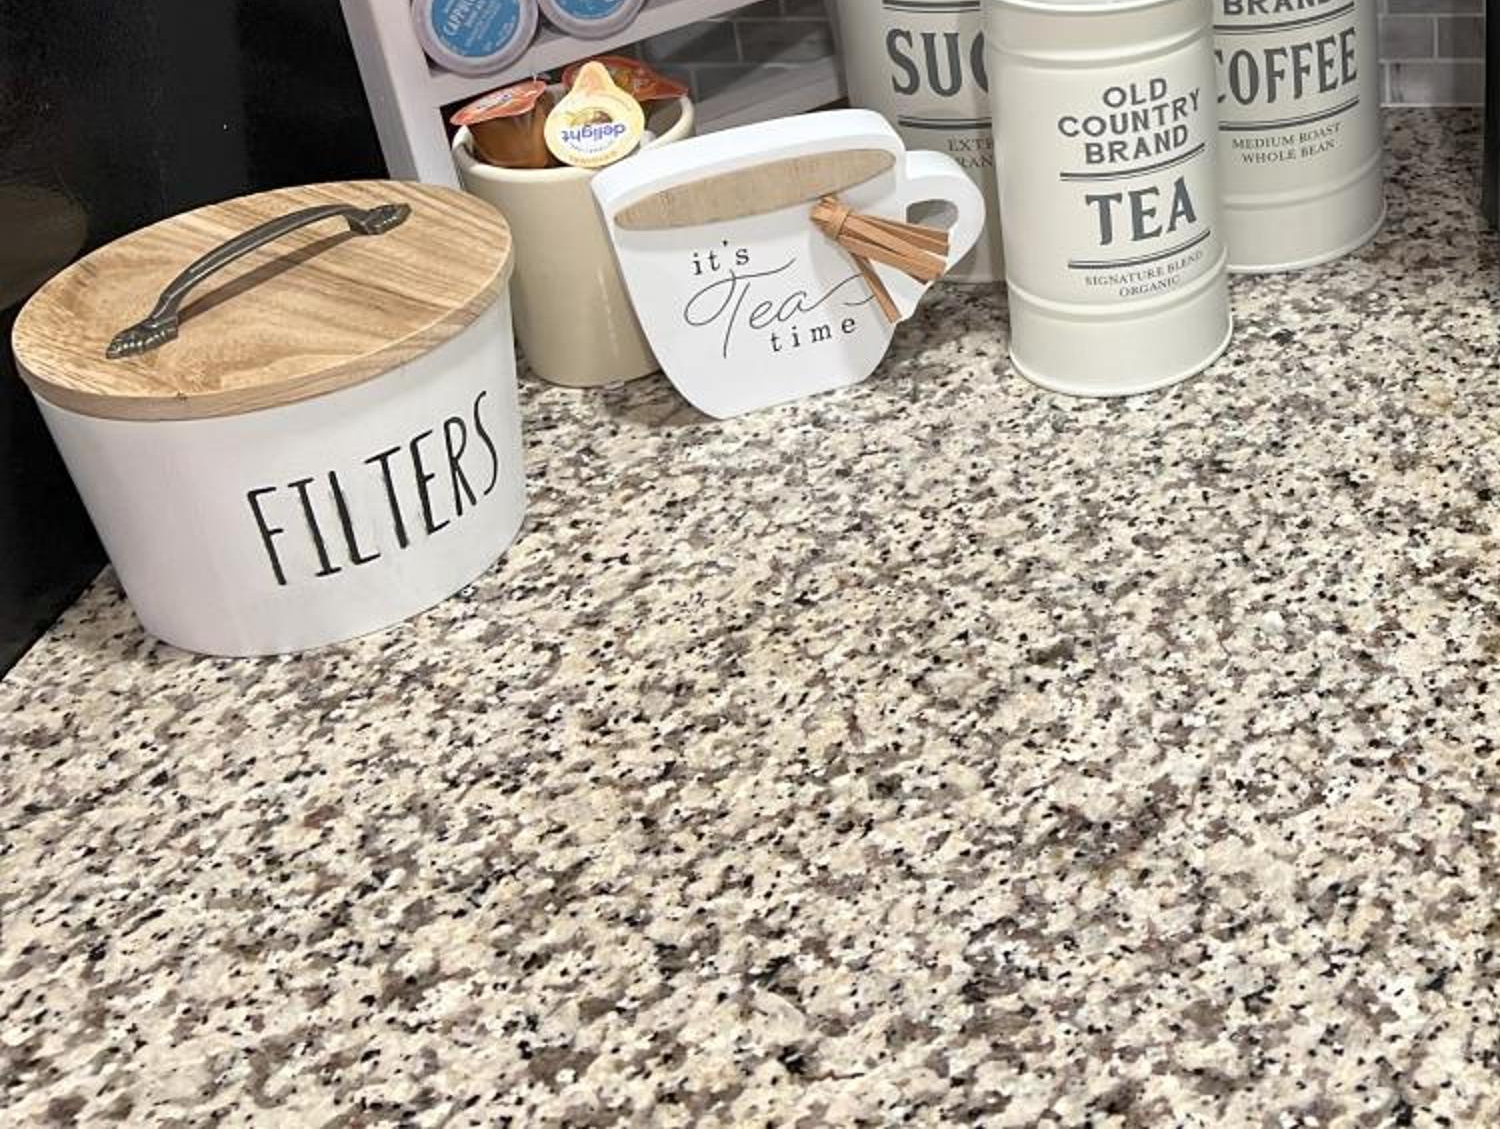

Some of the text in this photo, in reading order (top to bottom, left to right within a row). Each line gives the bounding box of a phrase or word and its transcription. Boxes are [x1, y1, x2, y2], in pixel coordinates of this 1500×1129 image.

[1103, 77, 1168, 108] OLD
[1058, 87, 1200, 137] COUNTRY
[561, 123, 627, 143] delight
[1085, 124, 1188, 164] BRAND
[1233, 122, 1342, 150] MEDIUM ROAST
[1242, 138, 1337, 164] WHOLE BEAN
[1085, 175, 1198, 245] TEA
[692, 240, 750, 275] it's
[1085, 251, 1203, 287] SIGNATURE BLEND
[1119, 274, 1182, 298] ORGANIC
[684, 257, 876, 359] Tea
[770, 314, 858, 353] time
[247, 389, 500, 586] FILTERS
